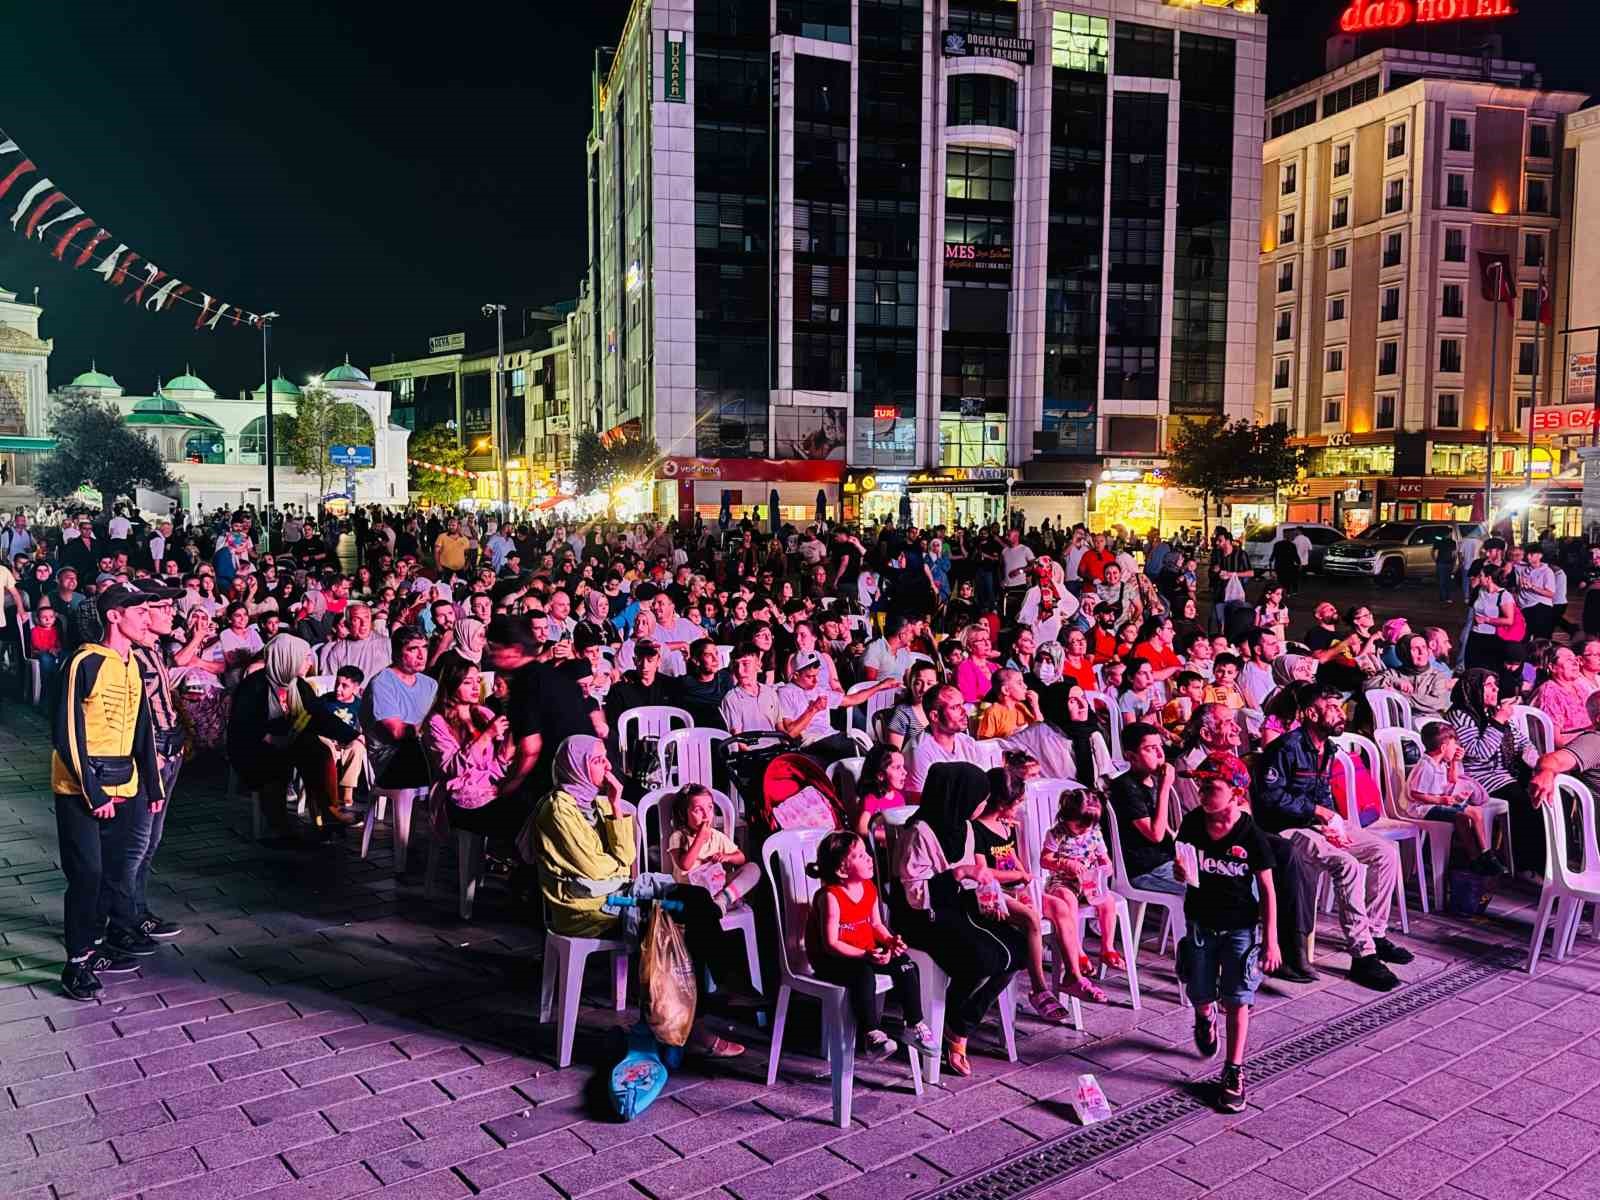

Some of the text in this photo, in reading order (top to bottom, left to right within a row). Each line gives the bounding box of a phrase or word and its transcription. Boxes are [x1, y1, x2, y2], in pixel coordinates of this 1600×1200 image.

[946, 245, 976, 259] MES
[1327, 433, 1351, 446] KFC
[1287, 484, 1309, 496] KFC
[1400, 484, 1422, 492] KFC
